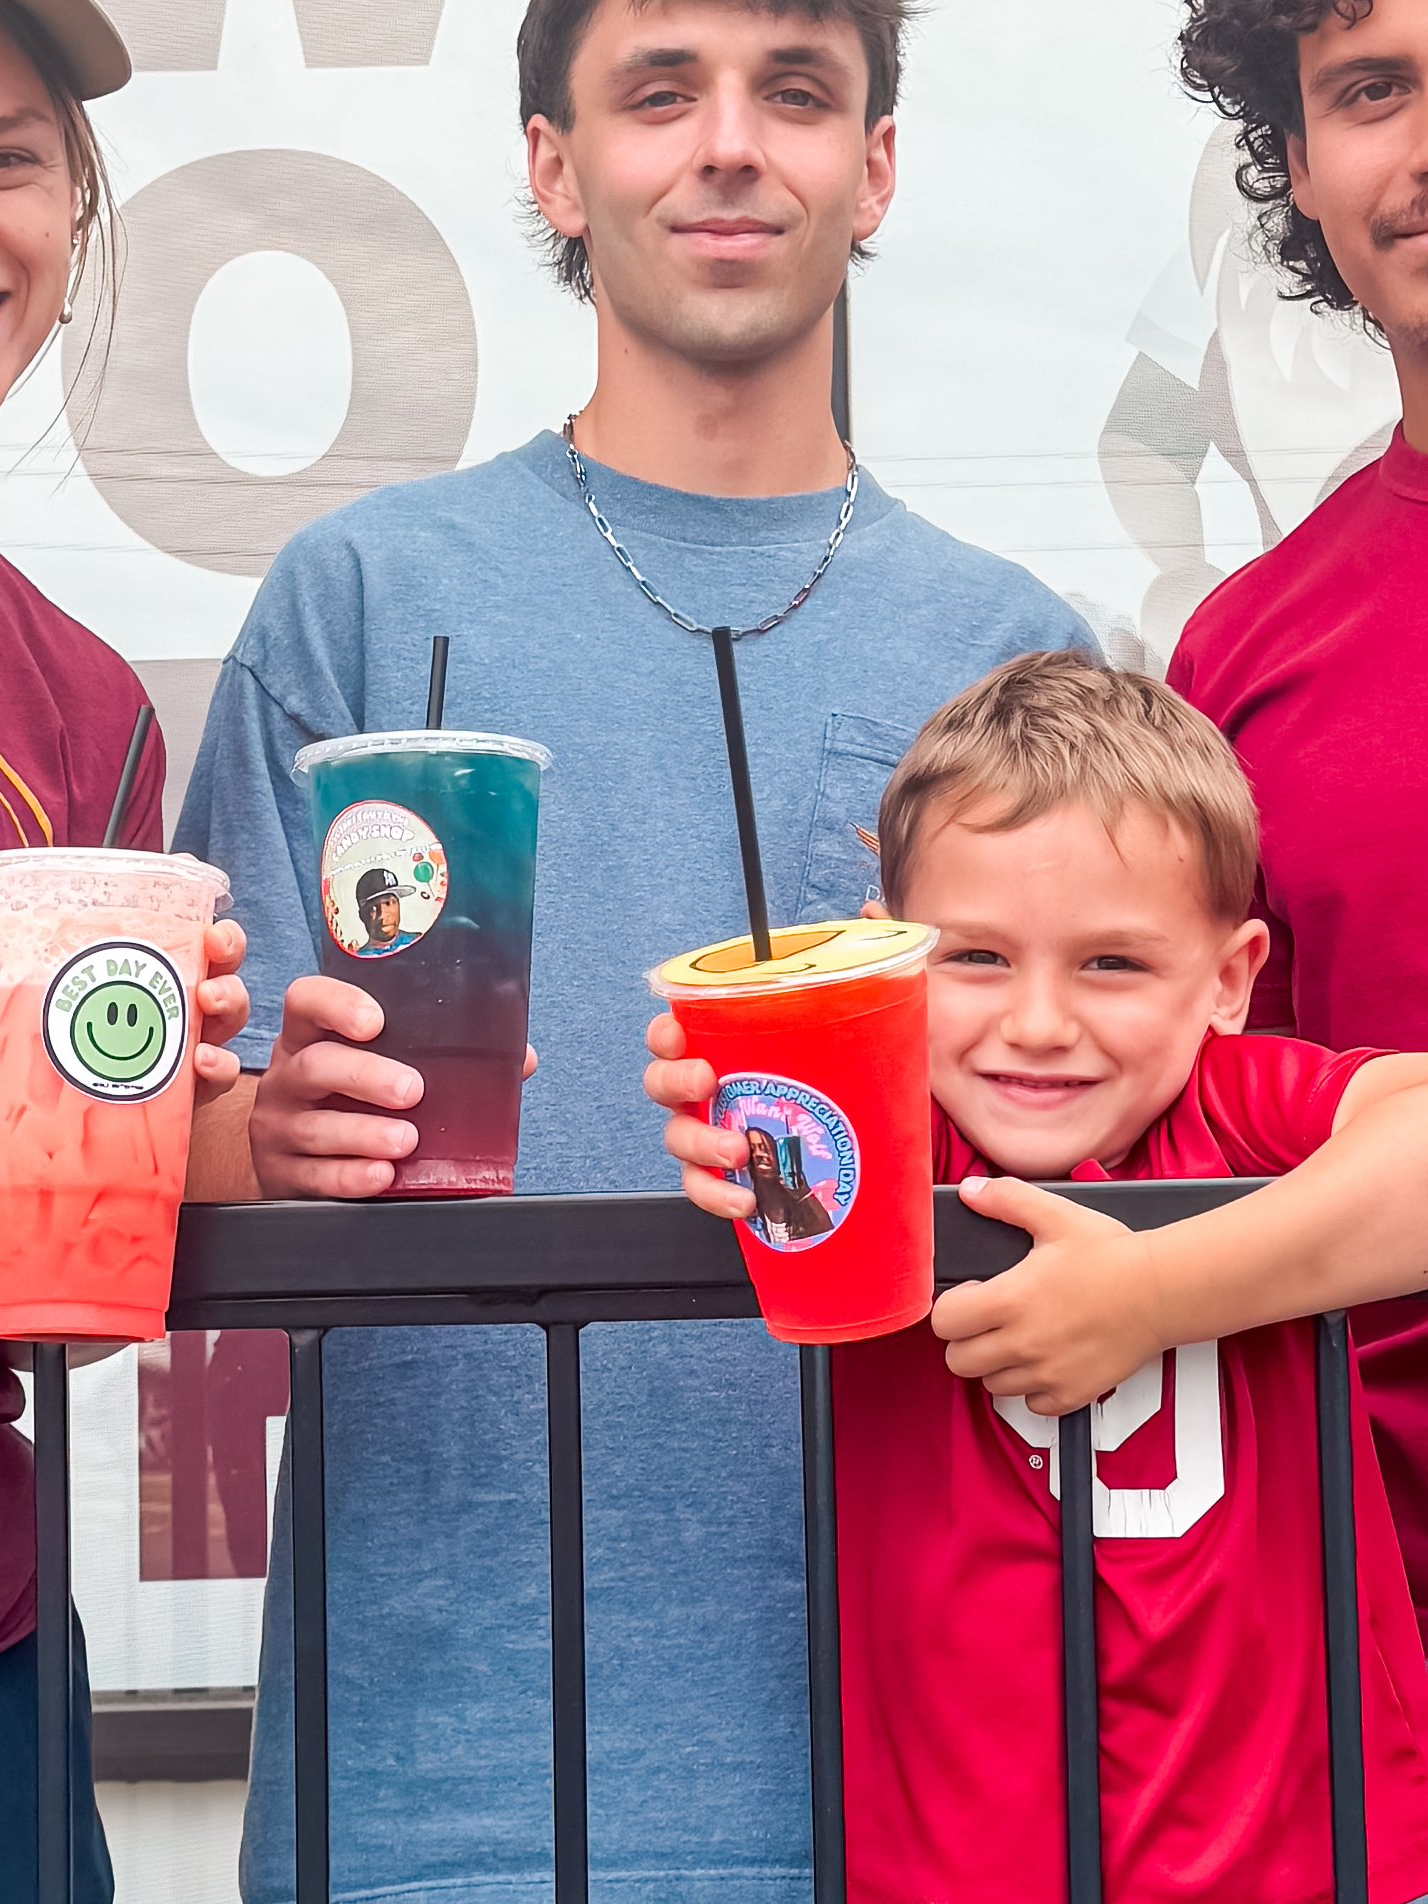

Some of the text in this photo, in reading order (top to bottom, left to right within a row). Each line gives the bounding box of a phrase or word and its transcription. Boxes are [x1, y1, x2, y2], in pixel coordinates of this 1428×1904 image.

[370, 824, 415, 843] SHOP
[55, 958, 180, 1021] BEST DAY EVER
[763, 1080, 856, 1166] APPRECIATION
[832, 1167, 857, 1207] DAY
